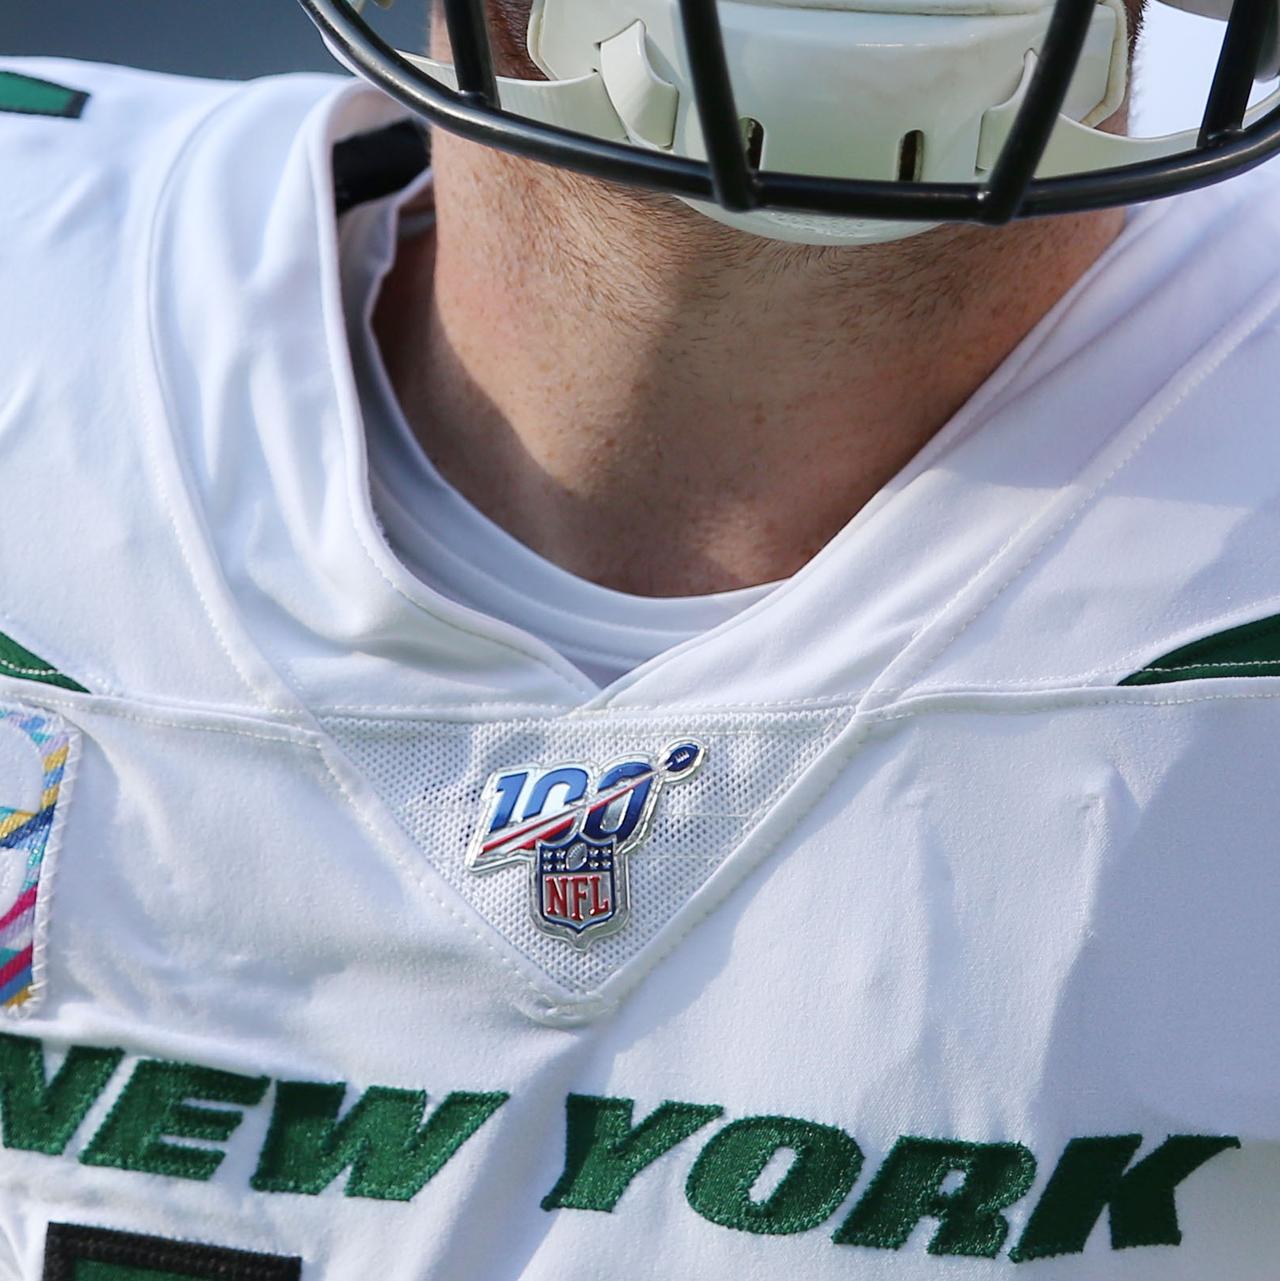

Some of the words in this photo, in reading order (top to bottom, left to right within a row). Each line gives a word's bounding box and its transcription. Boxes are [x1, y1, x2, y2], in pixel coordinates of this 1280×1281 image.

[486, 761, 654, 845] 100
[544, 874, 610, 921] NFL
[539, 1091, 1243, 1263] YORK
